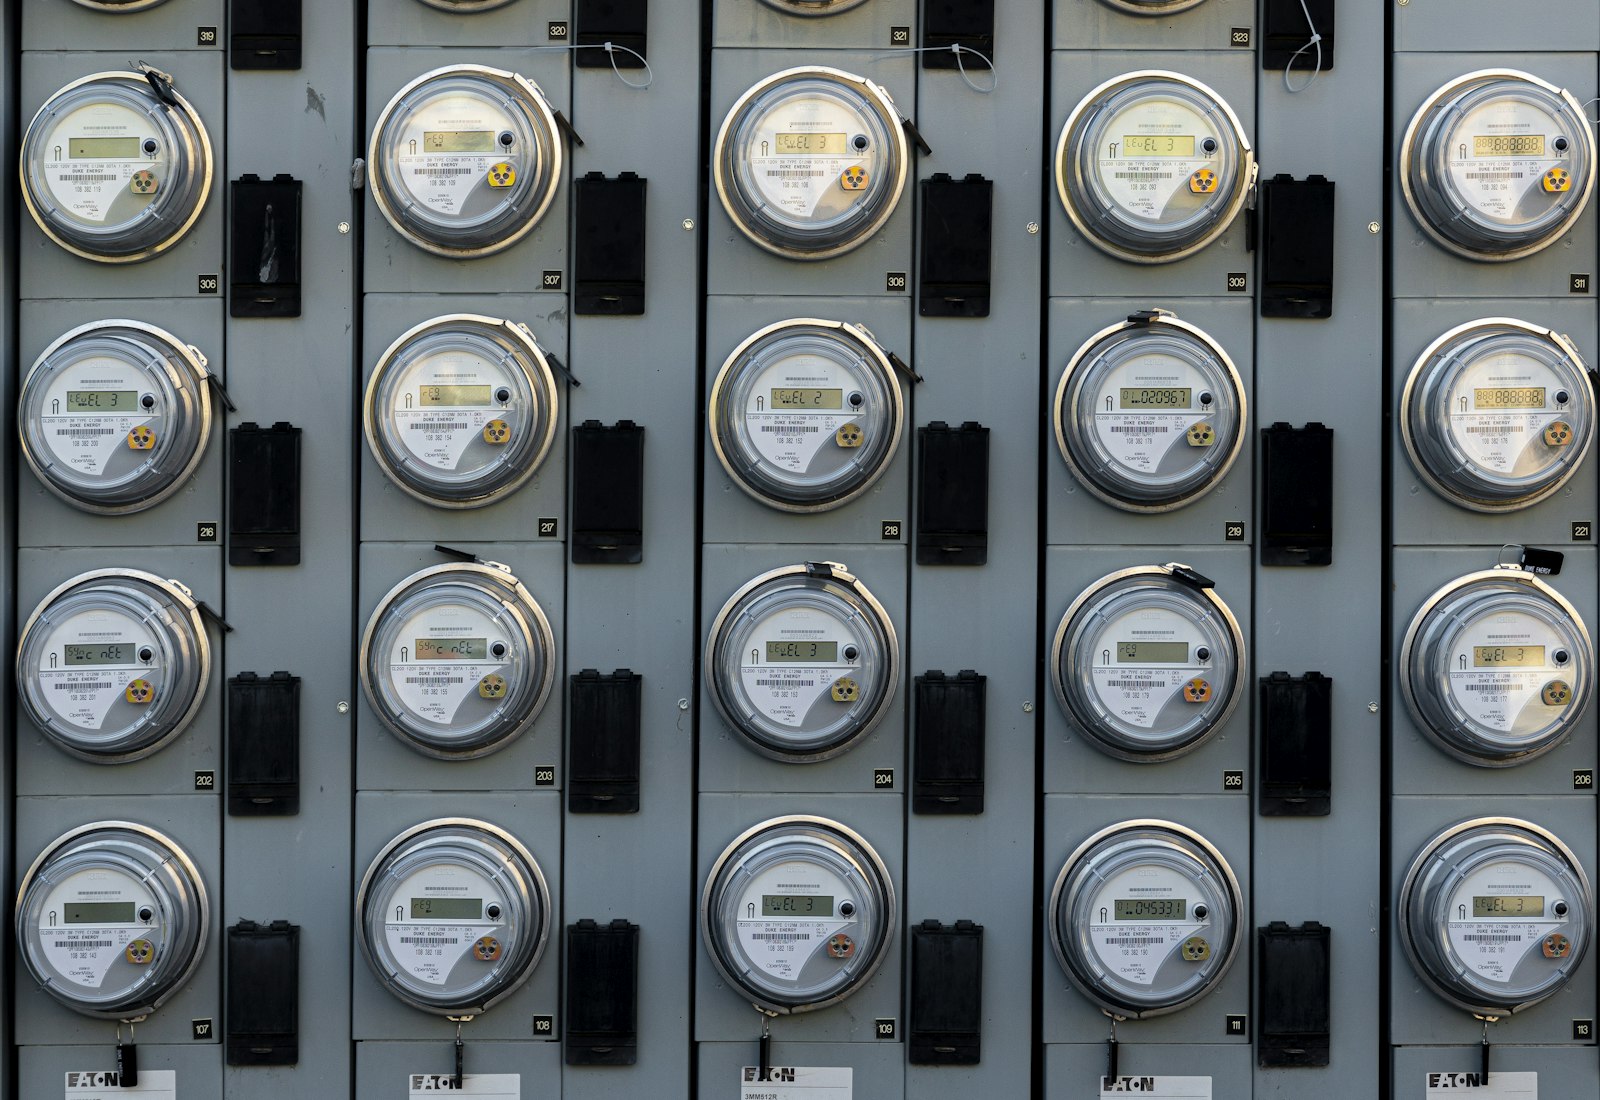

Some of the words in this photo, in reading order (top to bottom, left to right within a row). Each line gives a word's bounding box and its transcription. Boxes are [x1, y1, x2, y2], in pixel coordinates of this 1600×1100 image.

[550, 26, 566, 36] 320
[893, 31, 907, 40] 321
[200, 31, 214, 41] 319
[1232, 32, 1248, 42] 323
[200, 279, 216, 289] 306
[544, 275, 560, 285] 307
[888, 277, 904, 287] 308
[1228, 277, 1245, 287] 309
[1574, 279, 1585, 288] 311
[200, 527, 214, 536] 216
[541, 523, 554, 532] 217
[884, 526, 898, 535] 218
[1228, 527, 1242, 536] 219
[1575, 526, 1588, 536] 221
[537, 771, 552, 780] 203
[876, 774, 892, 784] 204
[1575, 775, 1591, 784] 206
[196, 776, 212, 785] 202
[1226, 776, 1242, 785] 205
[1136, 902, 1180, 914] 045331
[196, 1024, 209, 1034] 107
[536, 1021, 550, 1030] 108
[878, 1024, 892, 1033] 109
[1232, 1021, 1240, 1029] 111
[1577, 1025, 1588, 1034] 113
[68, 1073, 118, 1086] EATON
[1430, 1074, 1480, 1088] EATON
